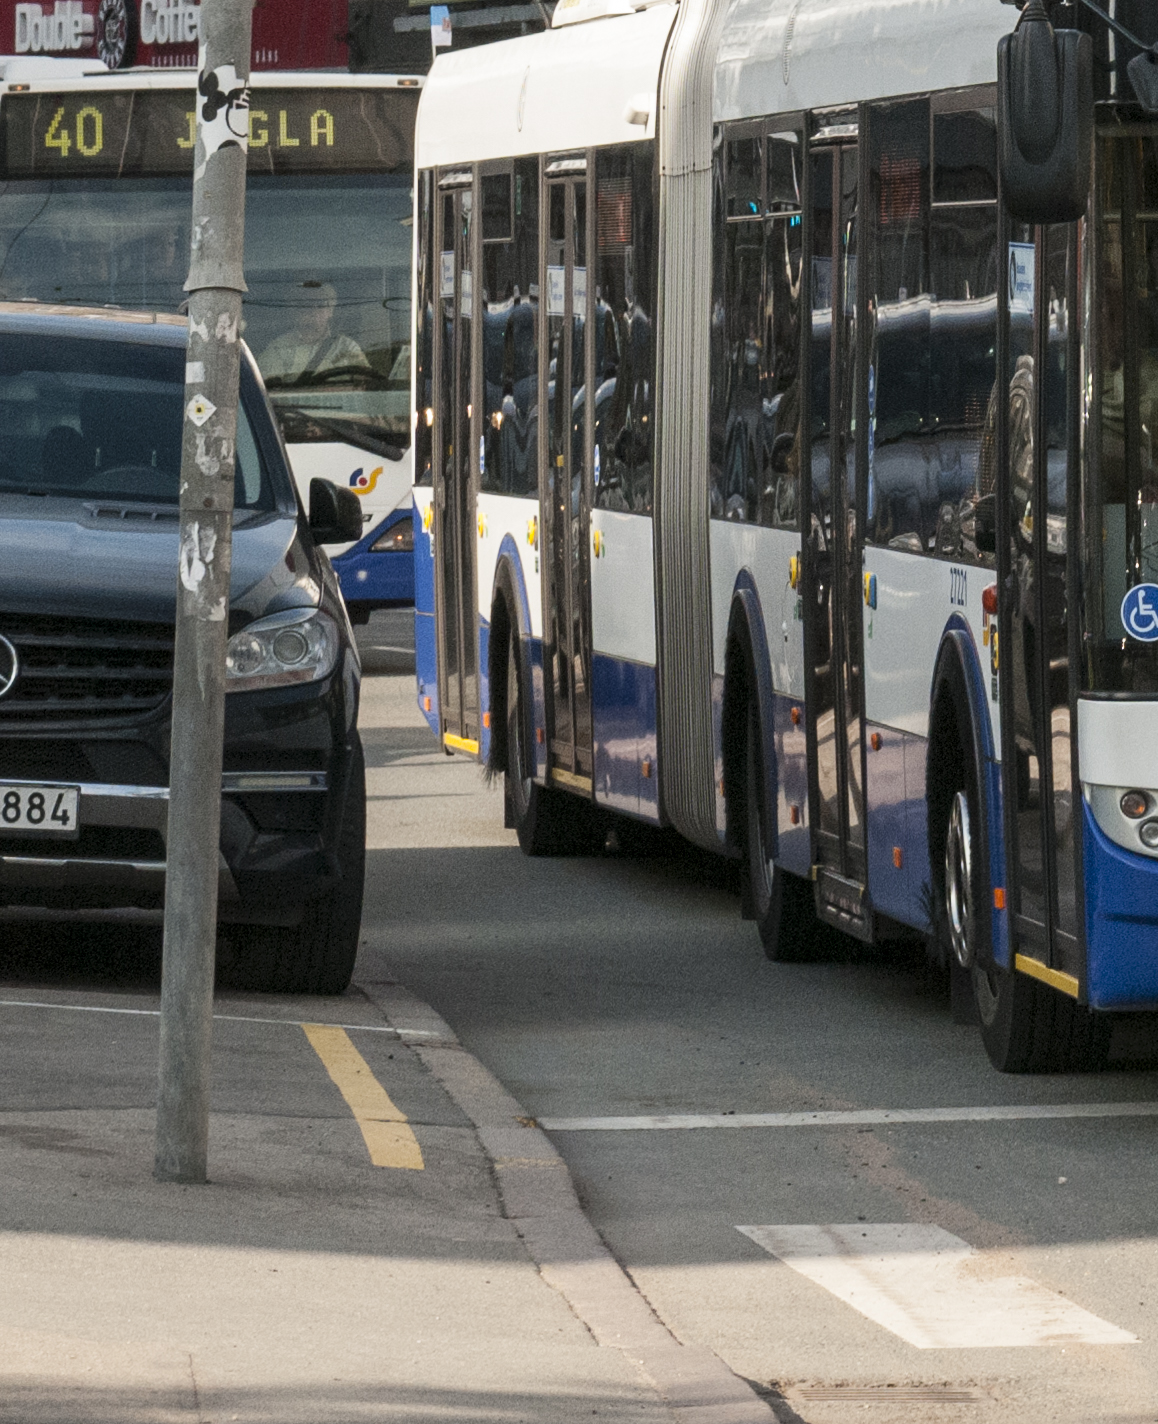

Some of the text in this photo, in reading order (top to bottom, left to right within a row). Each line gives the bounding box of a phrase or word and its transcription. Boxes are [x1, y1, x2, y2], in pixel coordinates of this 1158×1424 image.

[15, 0, 95, 53] Double
[45, 106, 335, 157] 40 JGLA
[2, 790, 70, 826] 884
